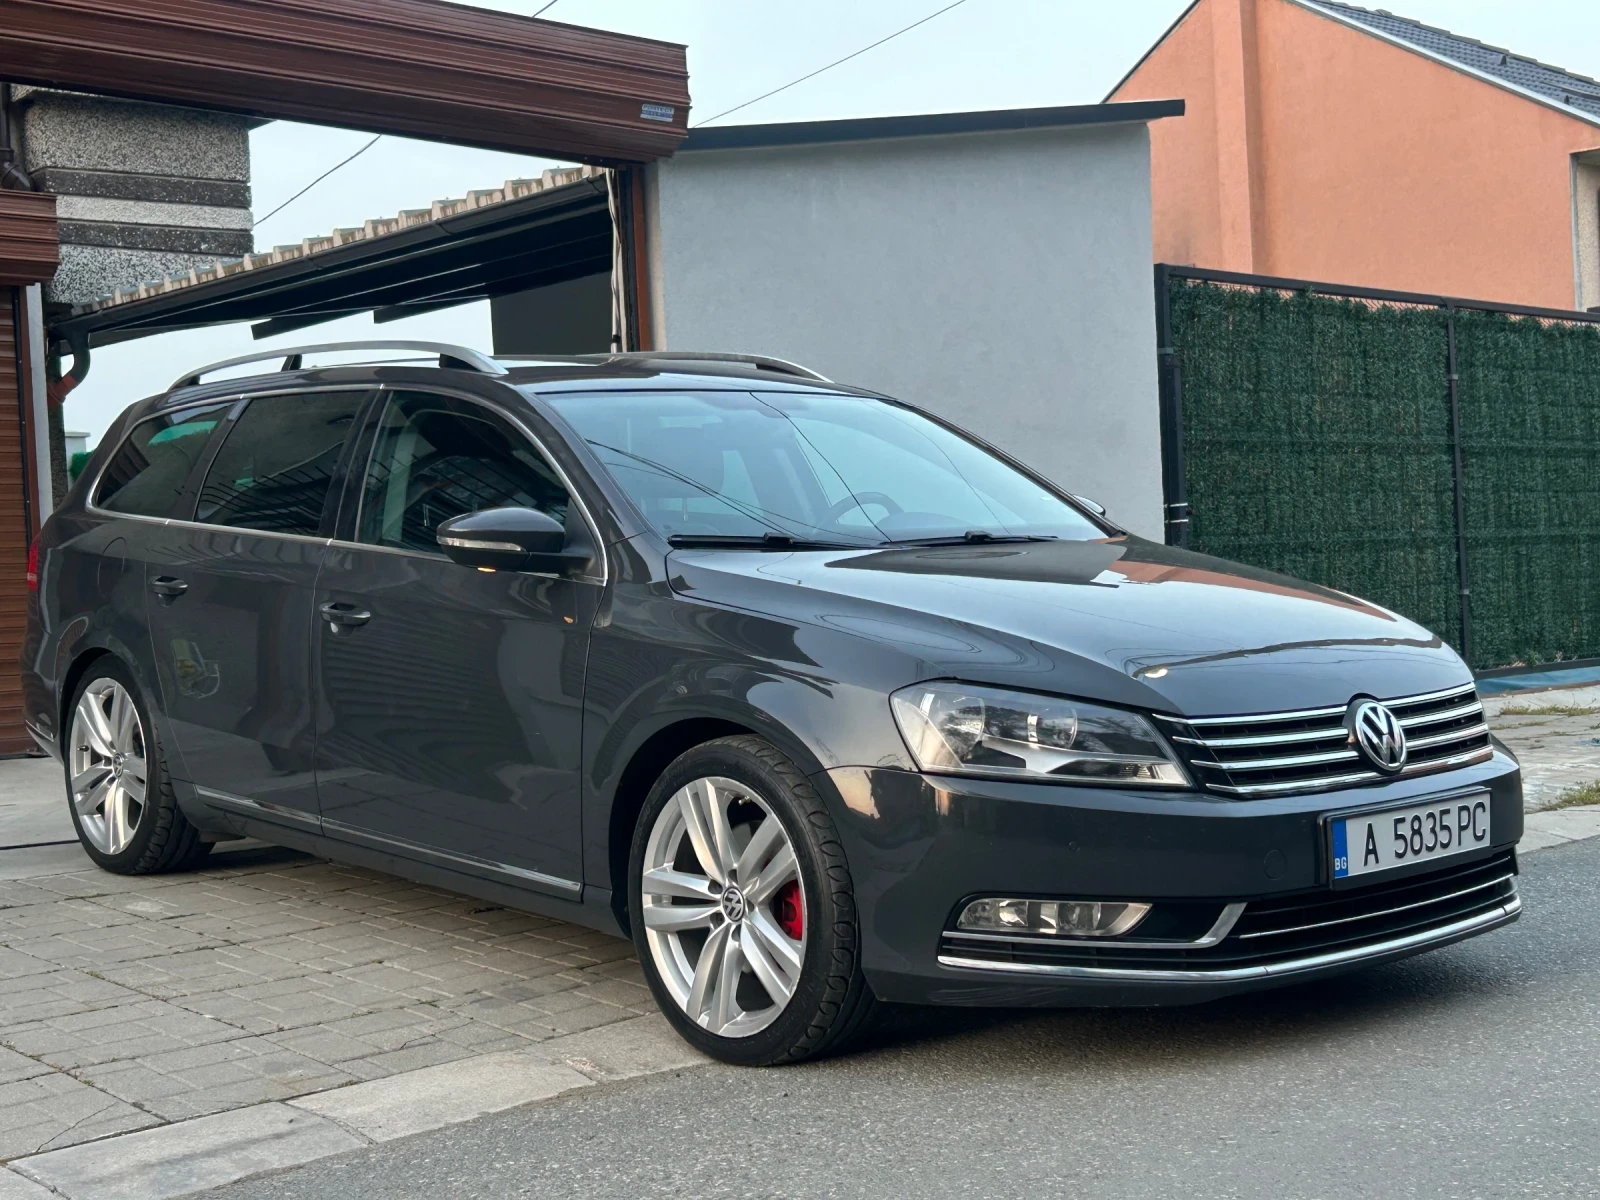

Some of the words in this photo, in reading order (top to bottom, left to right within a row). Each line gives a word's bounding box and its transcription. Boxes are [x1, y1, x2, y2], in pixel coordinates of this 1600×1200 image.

[1356, 702, 1406, 770] VW
[1334, 857, 1348, 871] BG
[1363, 822, 1380, 867] A
